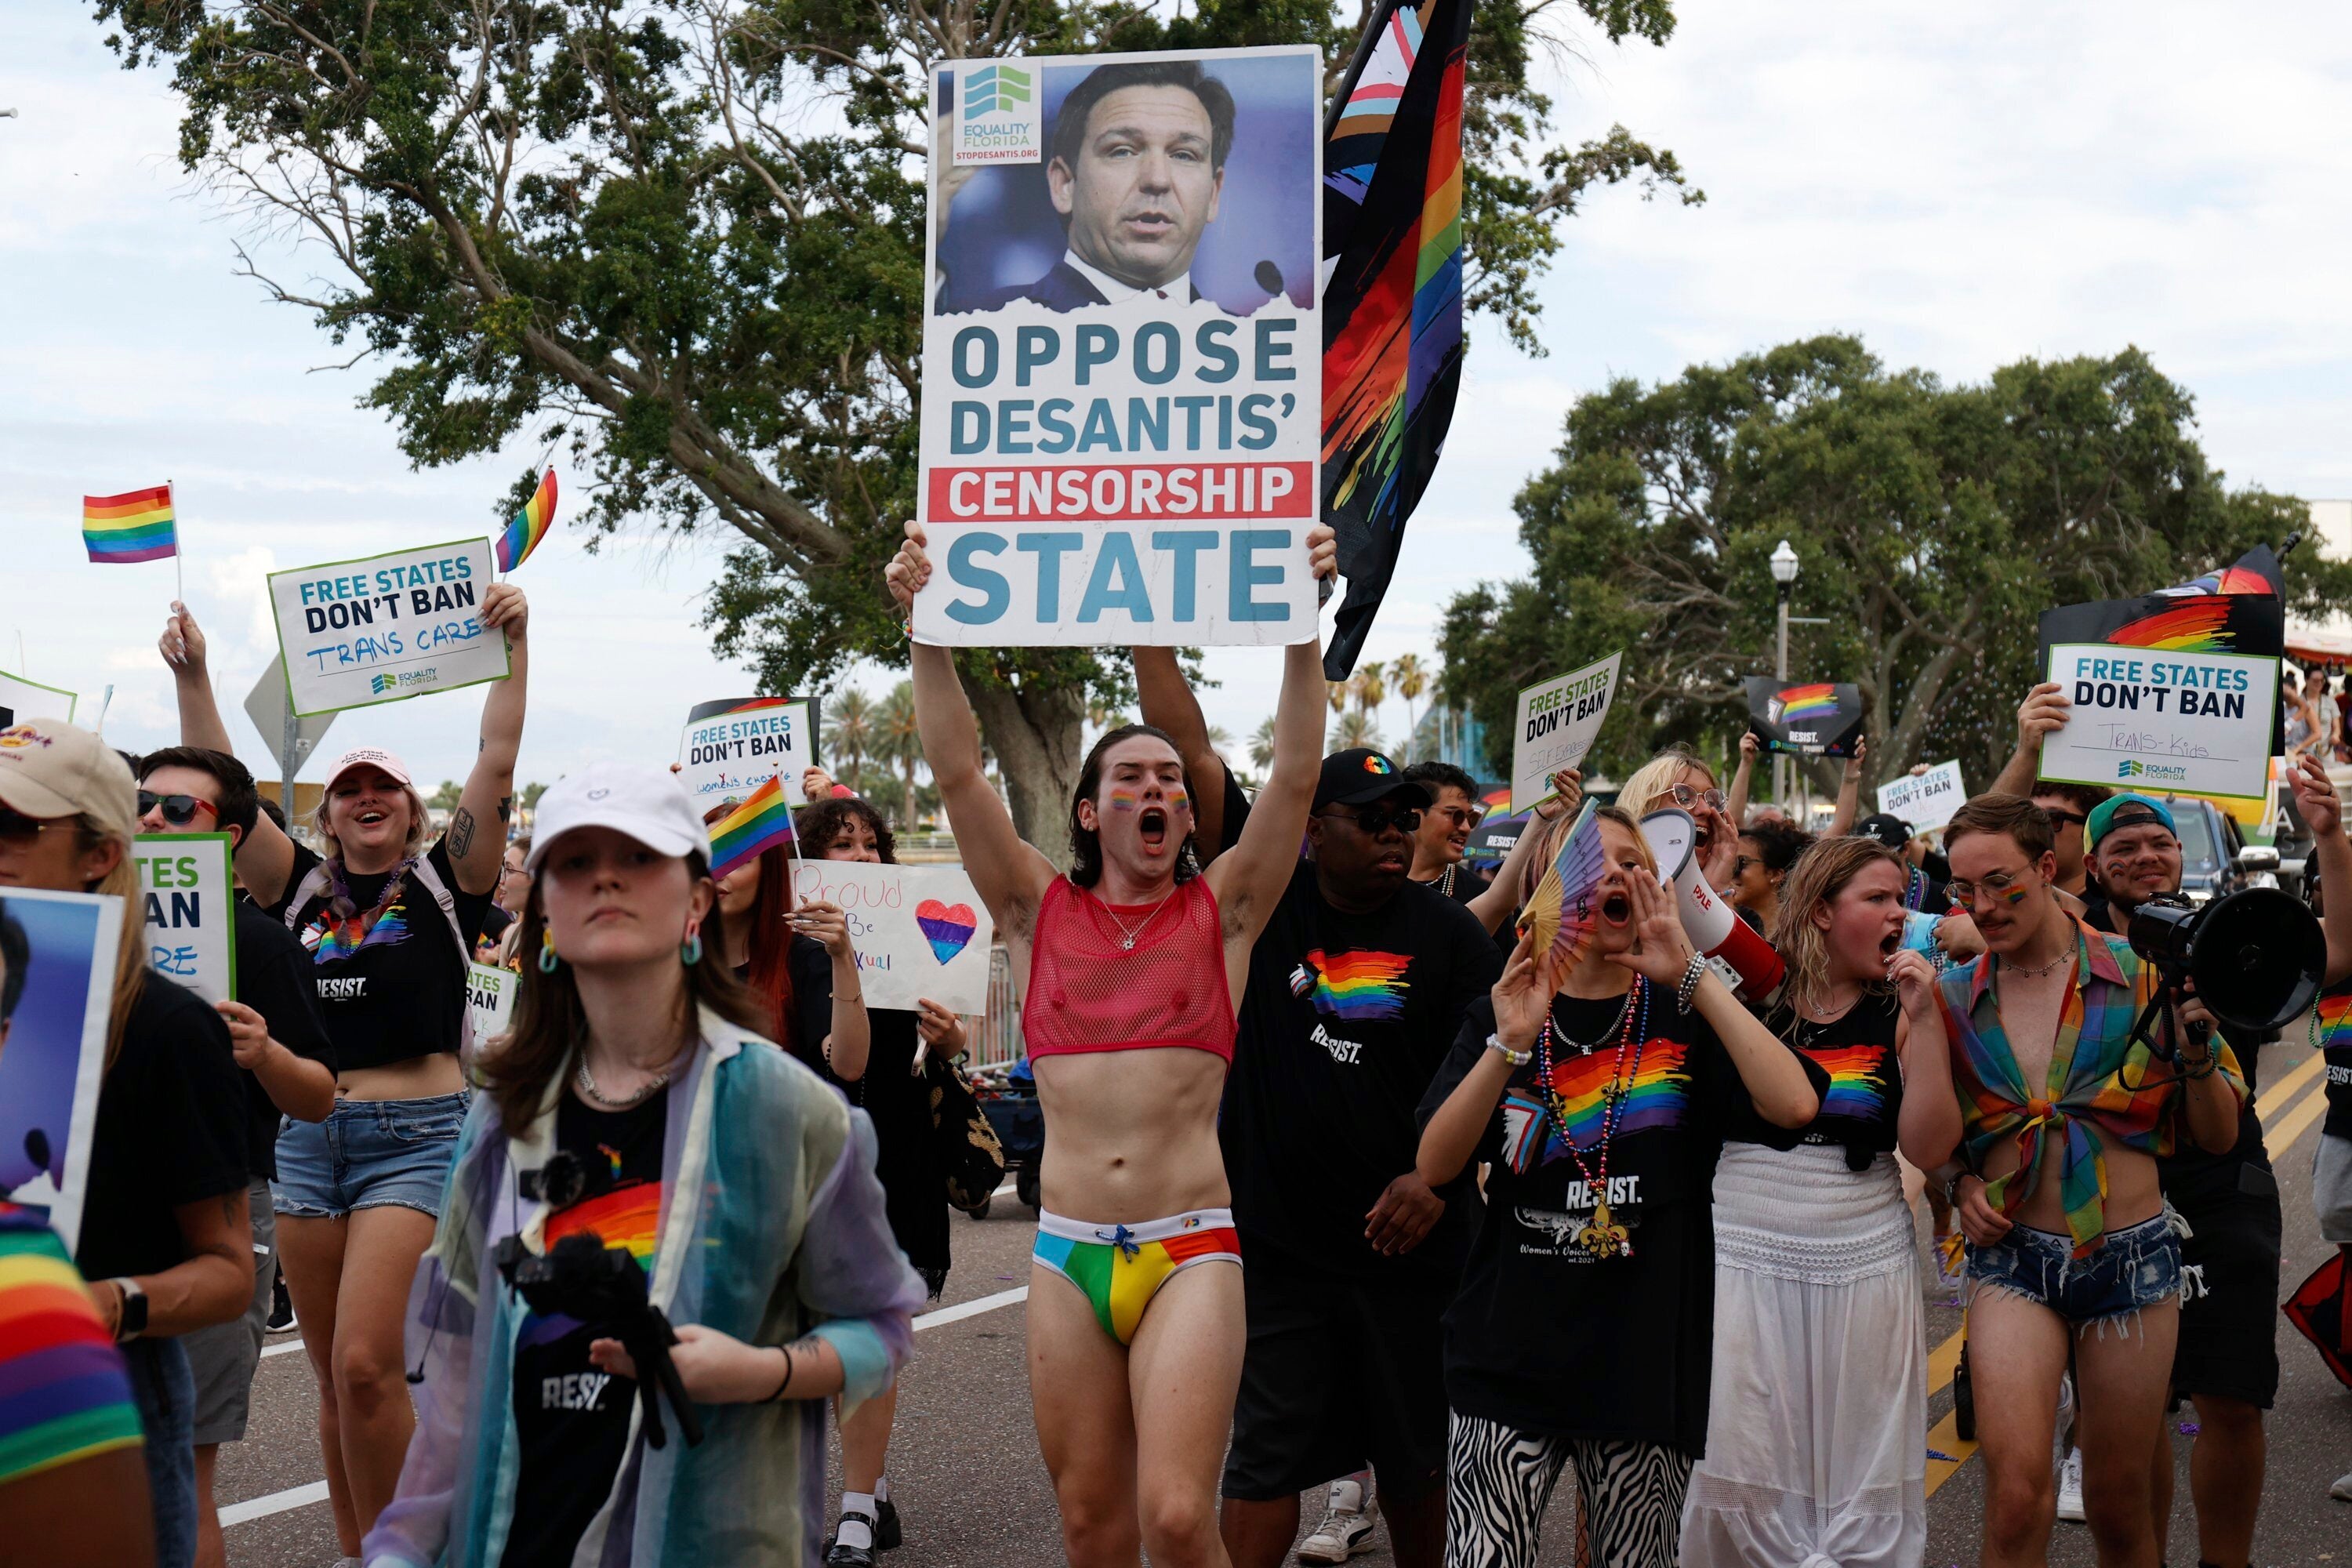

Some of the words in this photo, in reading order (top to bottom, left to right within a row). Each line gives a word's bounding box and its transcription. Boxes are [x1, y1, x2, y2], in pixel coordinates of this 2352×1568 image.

[964, 123, 1029, 136] EQUALITY
[964, 136, 1029, 147] FLORIDA
[956, 150, 1038, 159] STOPDESANTIS.ORG
[952, 318, 1297, 388] OPPOSE
[950, 393, 1295, 454] DESANTIS’
[949, 466, 1294, 516] CENSORSHIP
[300, 575, 369, 605] FREE
[376, 557, 471, 593] STATES
[944, 529, 1291, 625] STATE
[306, 594, 400, 633] DON’T
[411, 581, 475, 615] BAN
[307, 631, 403, 671] TRANS
[417, 618, 482, 650] CARE
[398, 667, 437, 681] EQUALITY
[400, 675, 438, 687] FLORIDA
[2076, 658, 2143, 682] FREE
[2151, 662, 2249, 691] STATES
[1528, 688, 1563, 718] FREE
[1565, 668, 1610, 702] STATES
[2074, 681, 2170, 712] DON’T
[2180, 690, 2245, 719] BAN
[692, 725, 727, 746] FREE
[731, 716, 790, 739] STATES
[1526, 703, 1573, 743] DON’T
[1577, 688, 1606, 721] BAN
[691, 740, 745, 765] DON’T
[751, 733, 791, 756] BAN
[1789, 731, 1818, 742] RESIST.
[1887, 782, 1908, 799] FREE
[1912, 769, 1950, 788] STATES
[2145, 772, 2186, 781] FLORIDA
[2146, 764, 2186, 775] EQUALITY
[1888, 790, 1920, 810] DON’T
[1925, 779, 1951, 797] BAN
[135, 857, 198, 887] TES
[793, 865, 902, 909] Proud
[143, 892, 200, 928] AN
[846, 913, 873, 936] Be
[151, 946, 198, 975] RE
[466, 971, 500, 993] ATES
[1310, 1023, 1363, 1065] RESIST.
